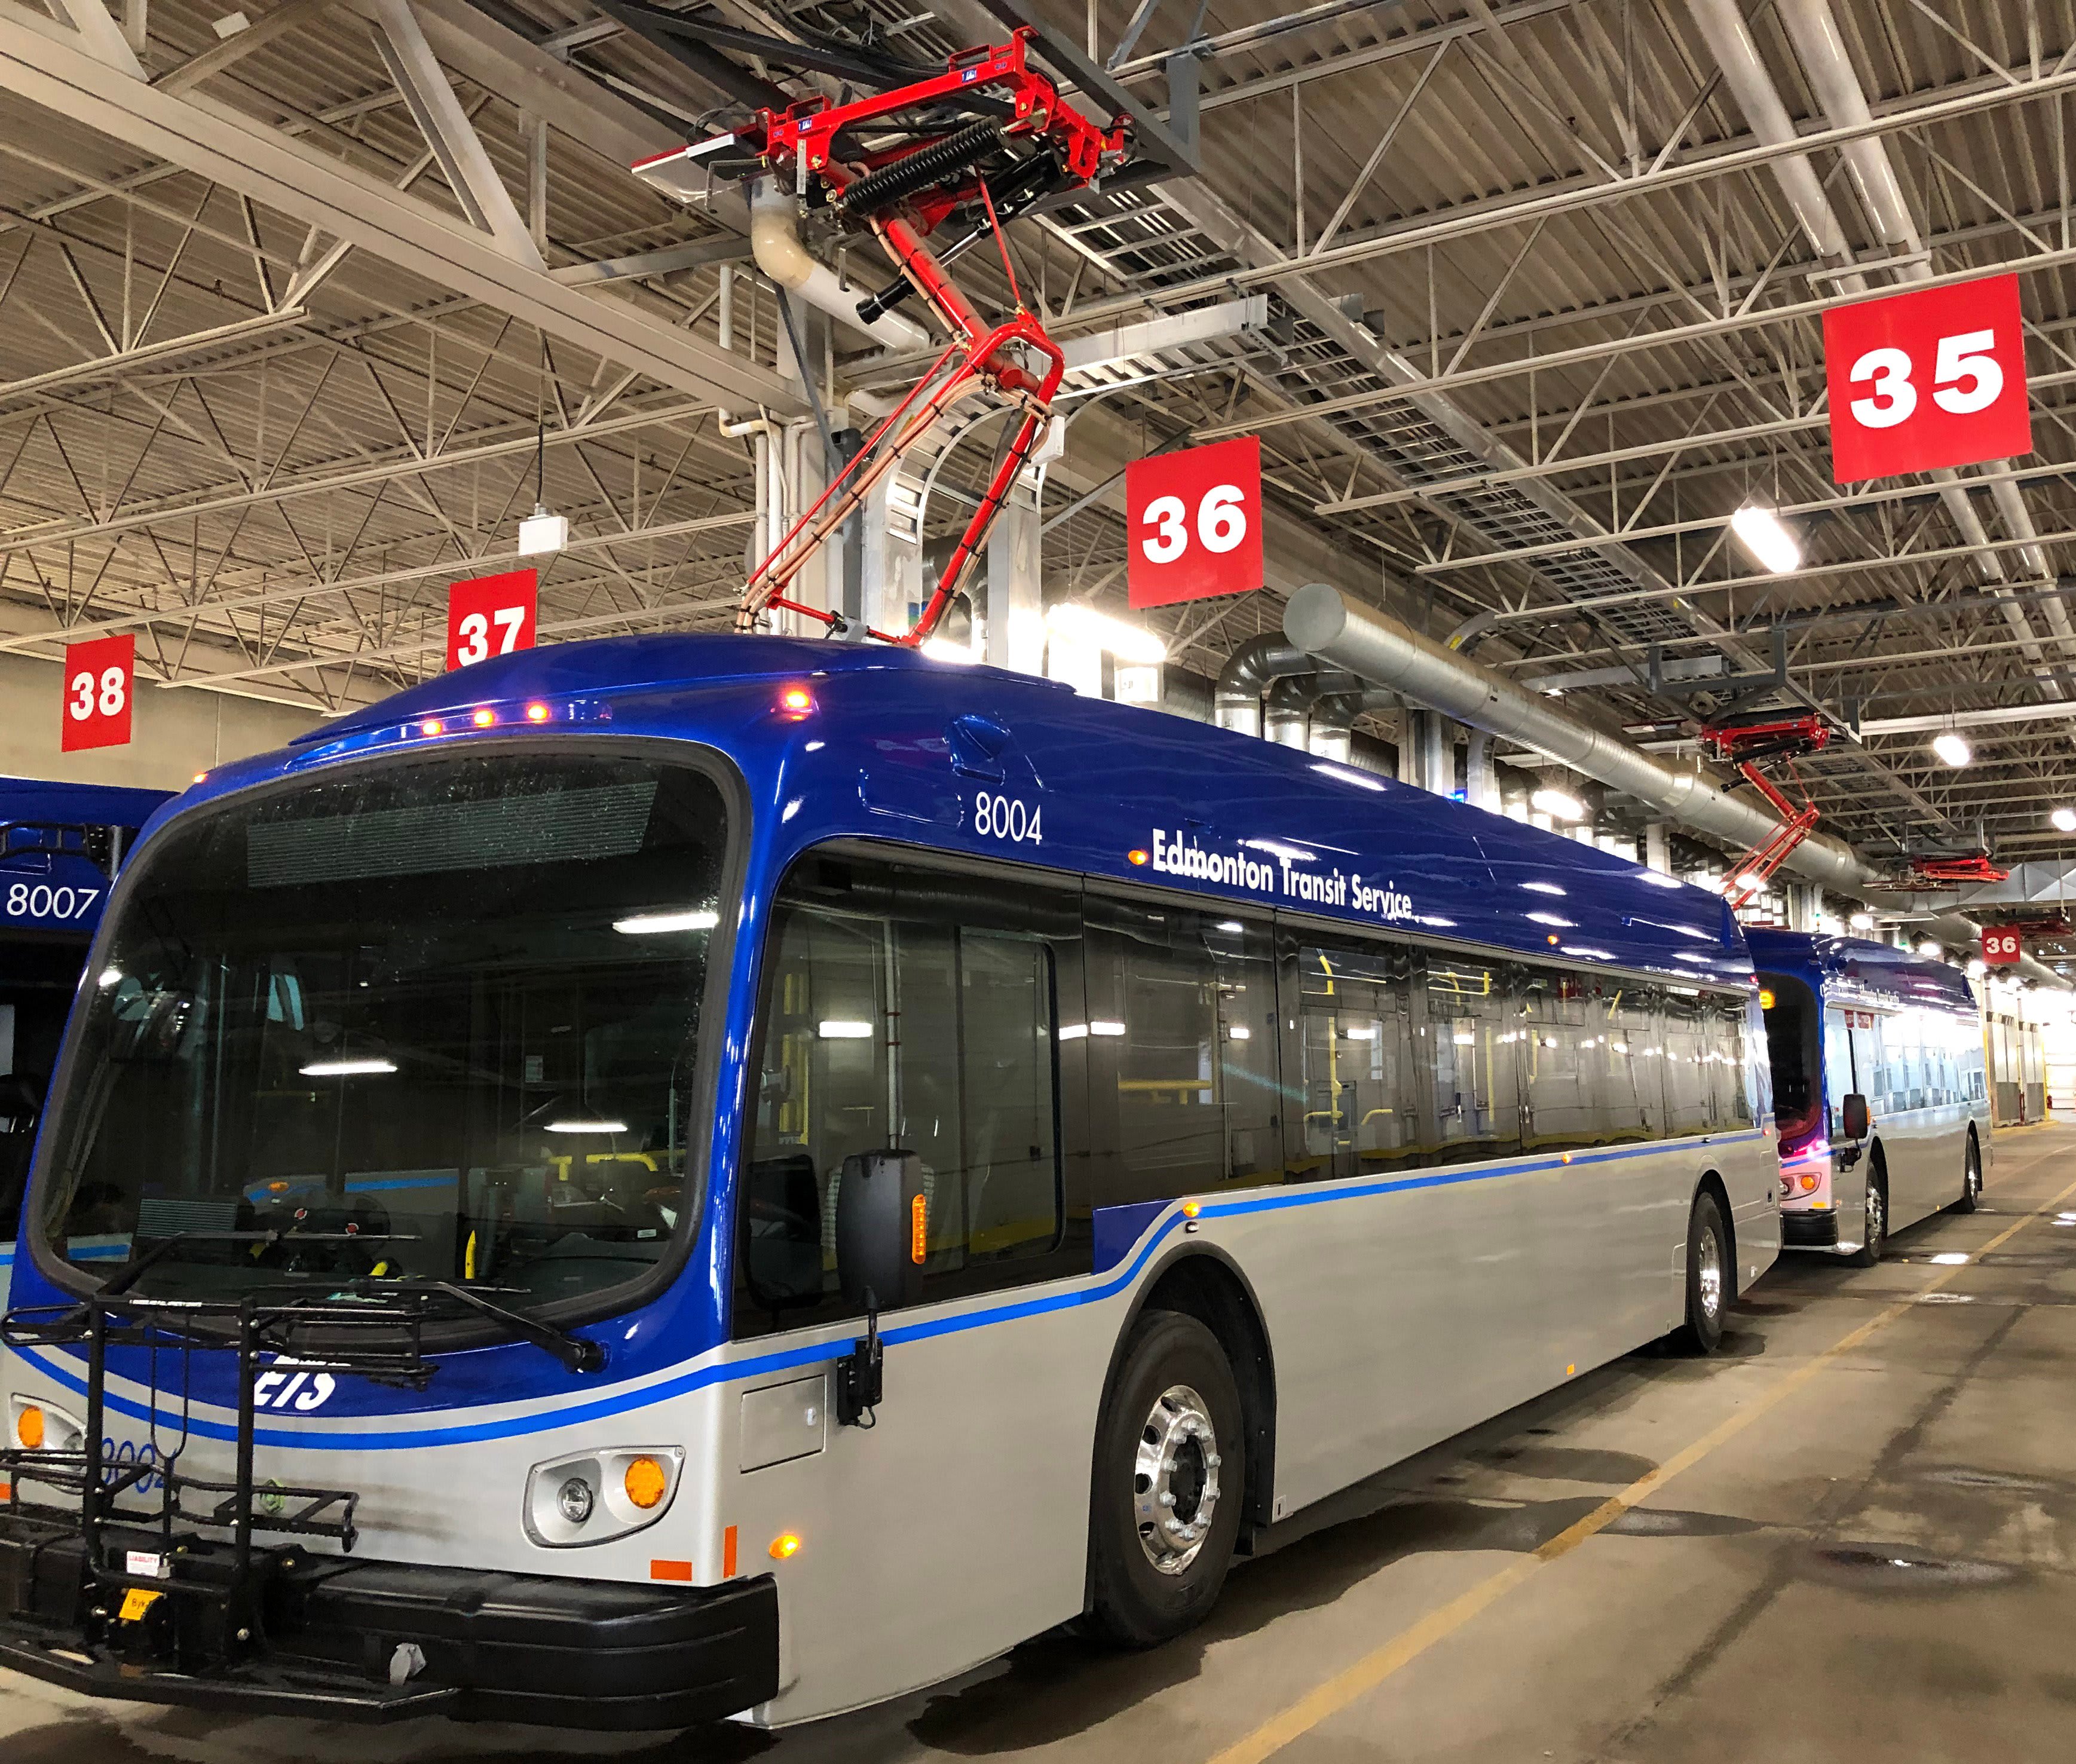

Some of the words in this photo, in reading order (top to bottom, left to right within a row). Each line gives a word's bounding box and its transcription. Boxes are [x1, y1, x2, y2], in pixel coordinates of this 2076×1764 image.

[1850, 329, 2004, 428] 35
[1142, 485, 1247, 564] 36
[458, 605, 525, 667] 37
[70, 666, 125, 721] 38
[975, 791, 1042, 845] 8004
[7, 883, 100, 919] 8007
[1153, 828, 1273, 892] Edmonton
[1279, 857, 1346, 906] Transit
[1351, 874, 1412, 919] Service
[1986, 936, 2016, 954] 36
